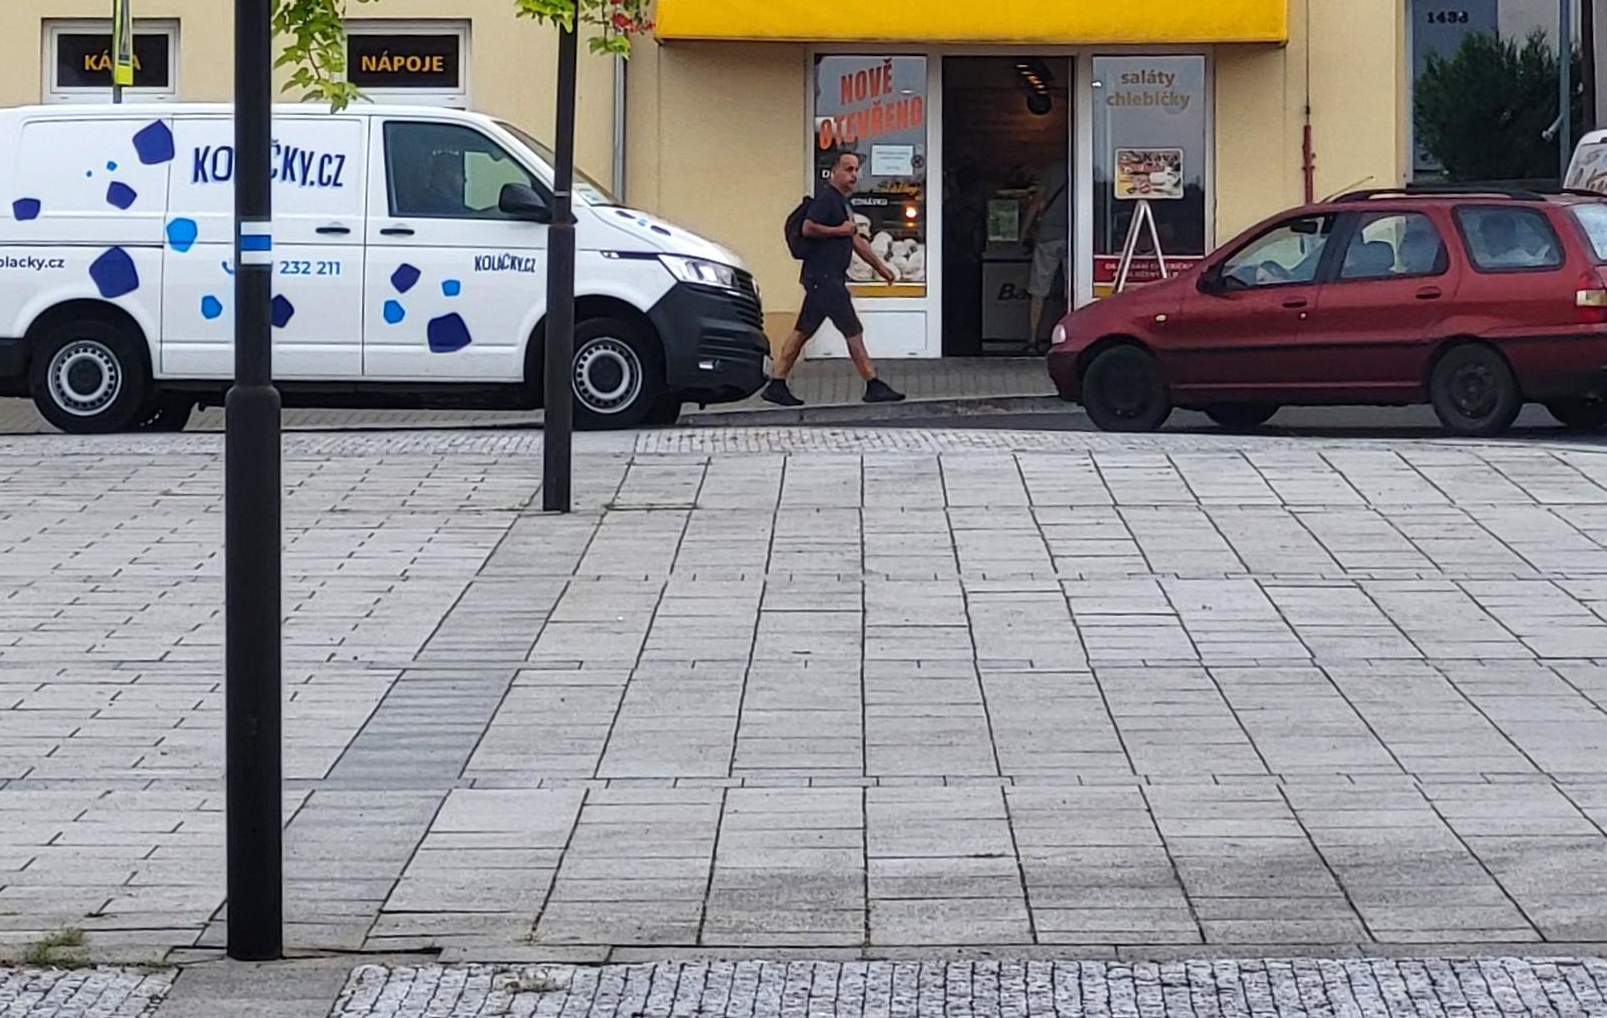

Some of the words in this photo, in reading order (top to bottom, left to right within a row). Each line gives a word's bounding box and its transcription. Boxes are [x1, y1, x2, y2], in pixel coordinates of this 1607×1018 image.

[84, 49, 142, 71] KÁA
[360, 49, 445, 72] NÁPOJE
[840, 57, 893, 106] NOVĚ
[1121, 69, 1176, 88] saláty
[1105, 91, 1191, 110] chlebíčky
[818, 95, 924, 151] OTEVŘENO
[191, 138, 347, 188] KOČKY.CZ
[279, 260, 312, 276] 232
[316, 260, 341, 276] 211
